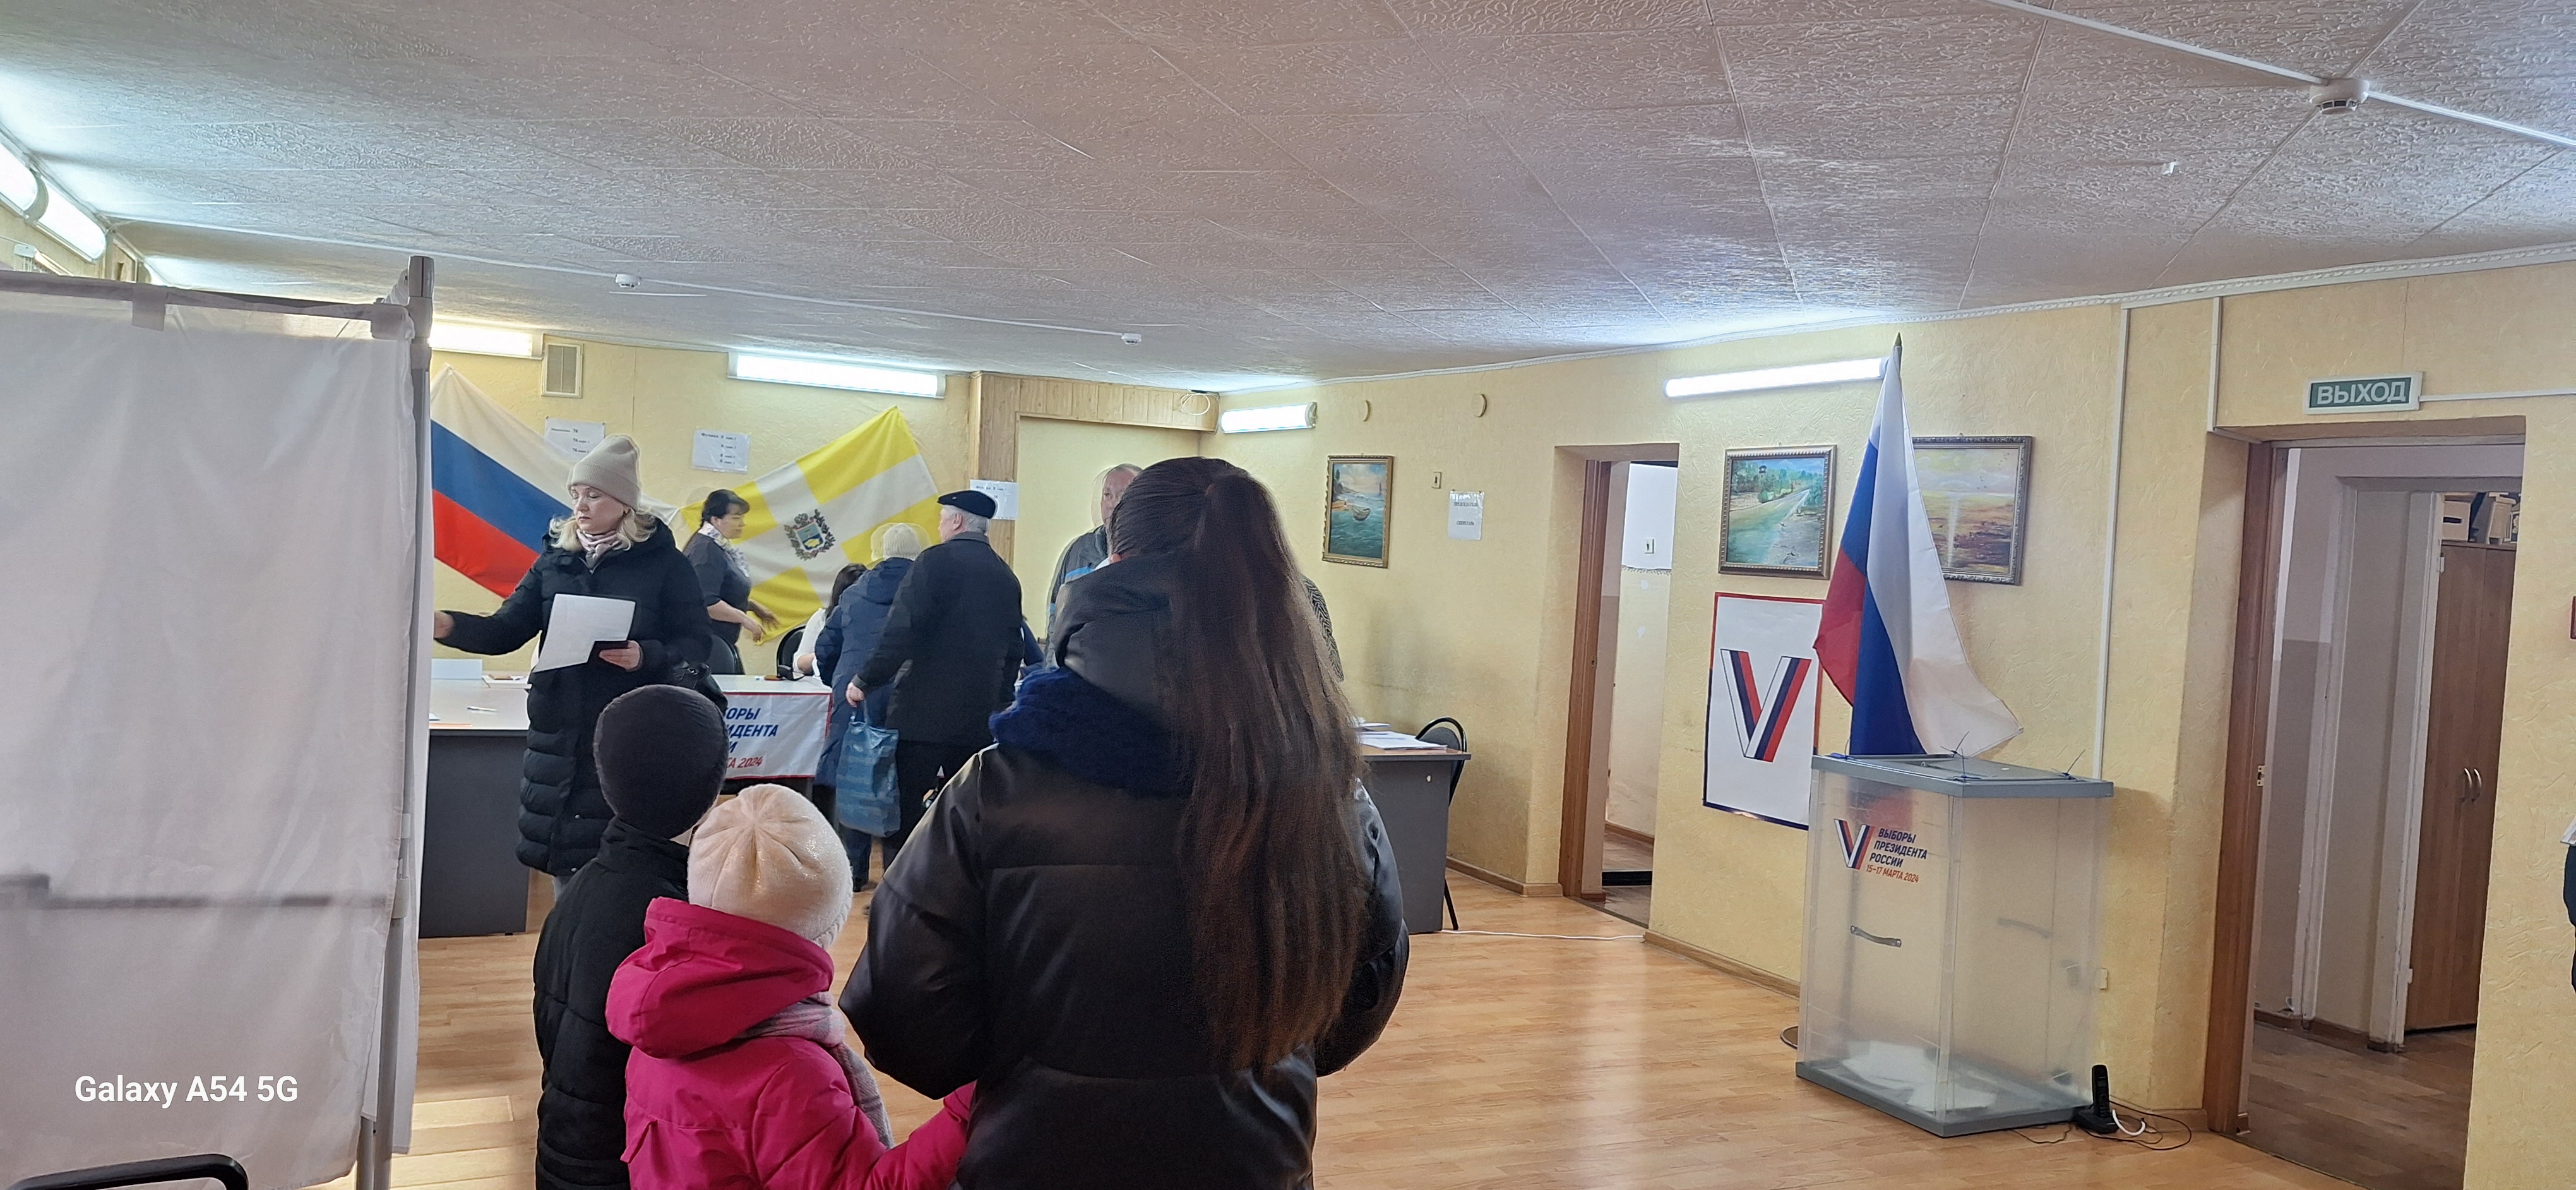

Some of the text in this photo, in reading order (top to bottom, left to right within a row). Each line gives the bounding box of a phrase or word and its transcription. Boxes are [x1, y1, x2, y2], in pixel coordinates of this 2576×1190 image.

[2317, 381, 2406, 405] ВЫХОД
[726, 707, 761, 720] ОРЫ
[1720, 648, 1812, 763] V
[727, 724, 778, 738] ИДЕНТА
[737, 757, 763, 768] 2024
[1878, 827, 1917, 844] ВЫБОРЫ
[1834, 818, 1876, 870] V
[1873, 840, 1928, 860] ПРЕЗИДЕНТА
[1869, 852, 1904, 868] РОССИИ
[1883, 868, 1904, 880] МАРТА
[1904, 872, 1919, 883] 2024
